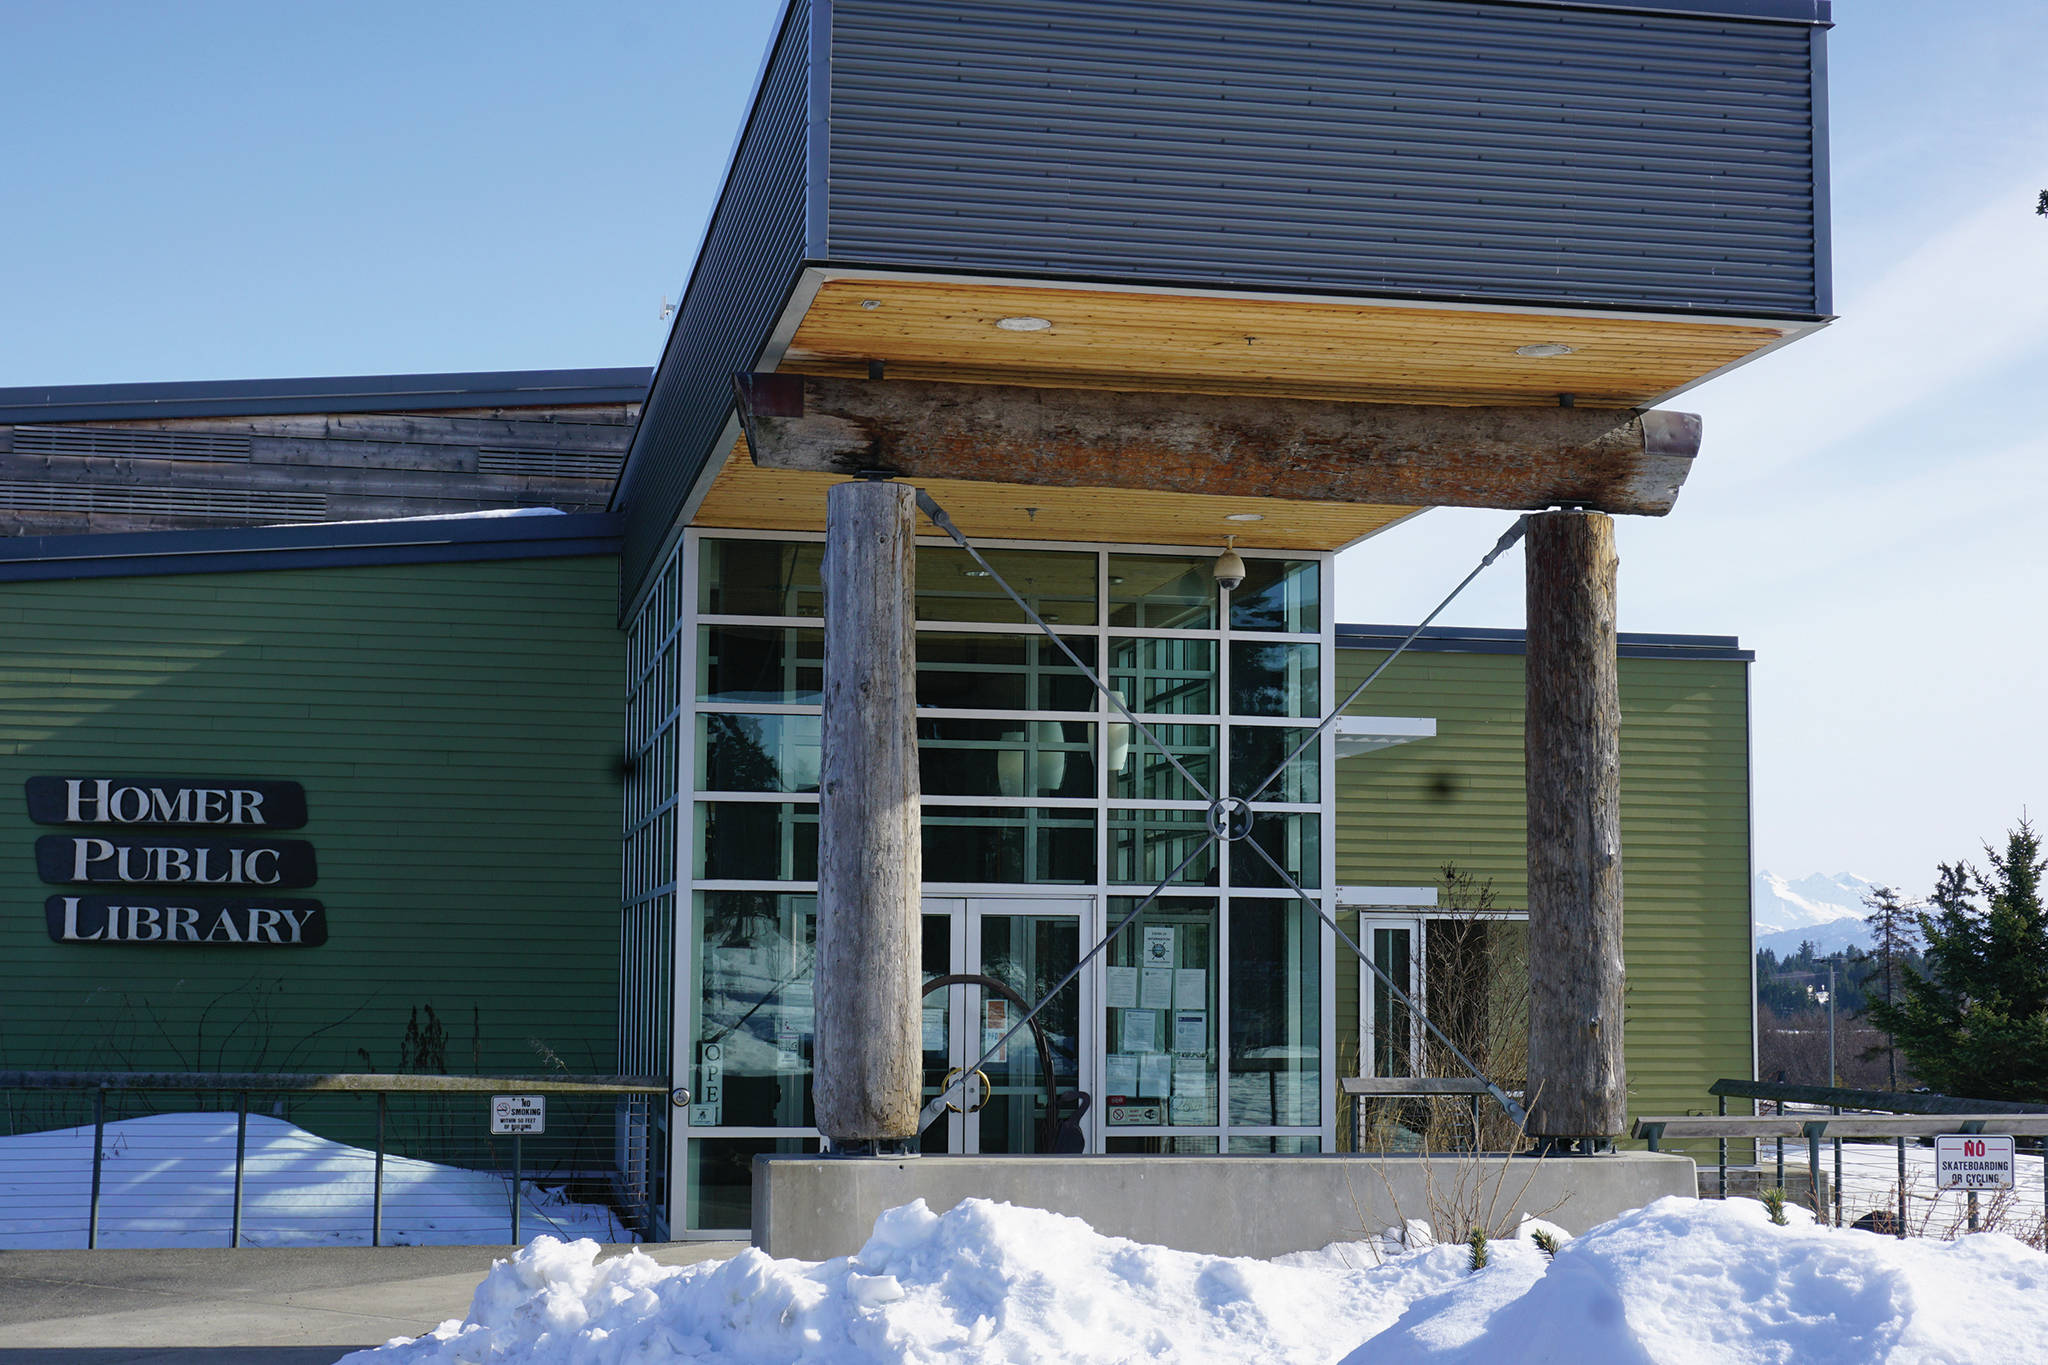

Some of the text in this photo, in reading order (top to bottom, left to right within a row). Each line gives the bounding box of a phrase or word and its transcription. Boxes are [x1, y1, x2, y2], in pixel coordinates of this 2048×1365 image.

[65, 779, 266, 825] HOMER
[71, 838, 281, 884] PUBLIC
[62, 897, 316, 943] LIBRARY
[705, 1044, 721, 1124] OPE
[1942, 1161, 2009, 1171] SKATEBOARDING
[1964, 1142, 1986, 1157] NO
[1952, 1174, 1999, 1184] OR CYCLING
